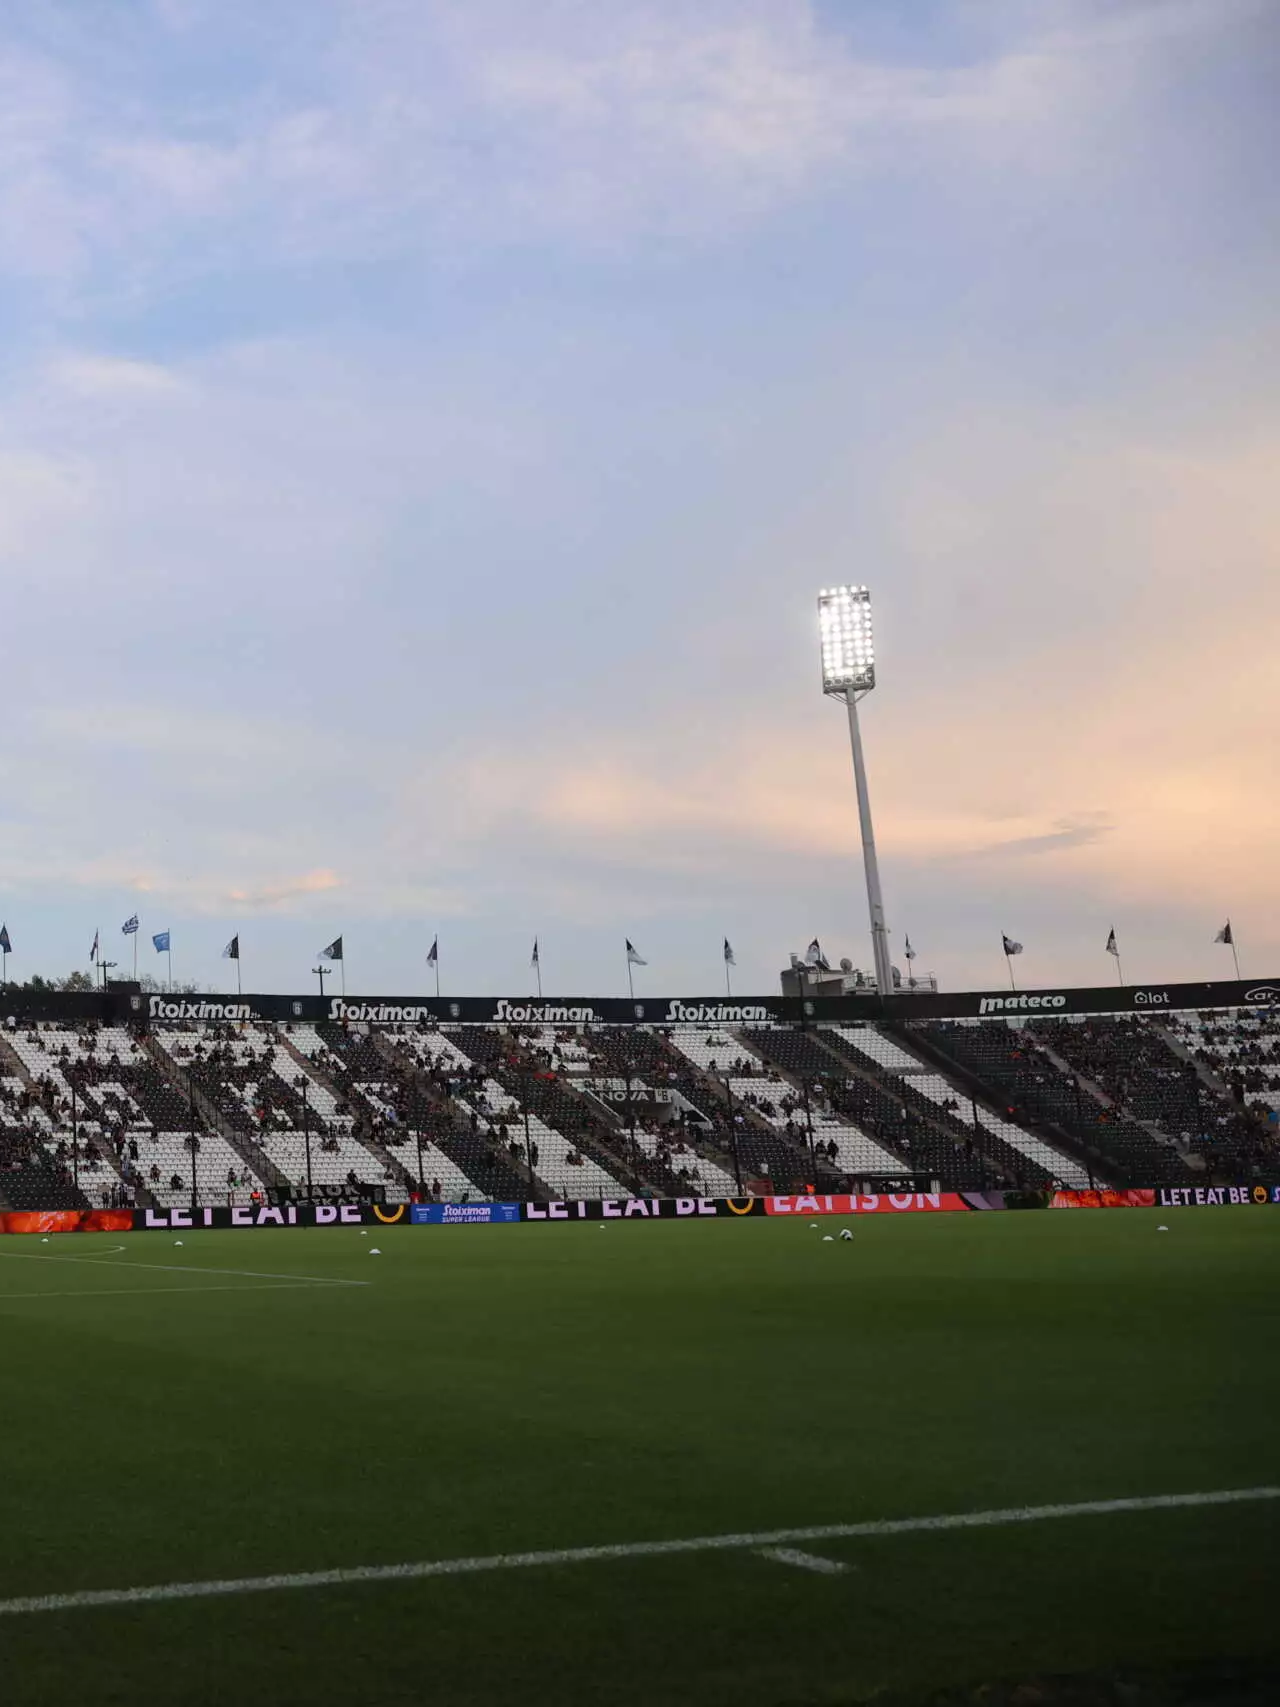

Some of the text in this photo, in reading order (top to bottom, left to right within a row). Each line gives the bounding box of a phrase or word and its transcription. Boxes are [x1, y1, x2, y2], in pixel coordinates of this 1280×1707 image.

[149, 995, 250, 1019] Stoiximan
[328, 998, 428, 1021] Stoiximan
[493, 999, 594, 1021] Stoiximan
[665, 1000, 767, 1021] Stoiximan
[979, 994, 1066, 1014] mateco
[600, 1091, 650, 1101] NOVA
[1161, 1187, 1250, 1206] LET EAT BE
[442, 1204, 491, 1216] Stoiximan
